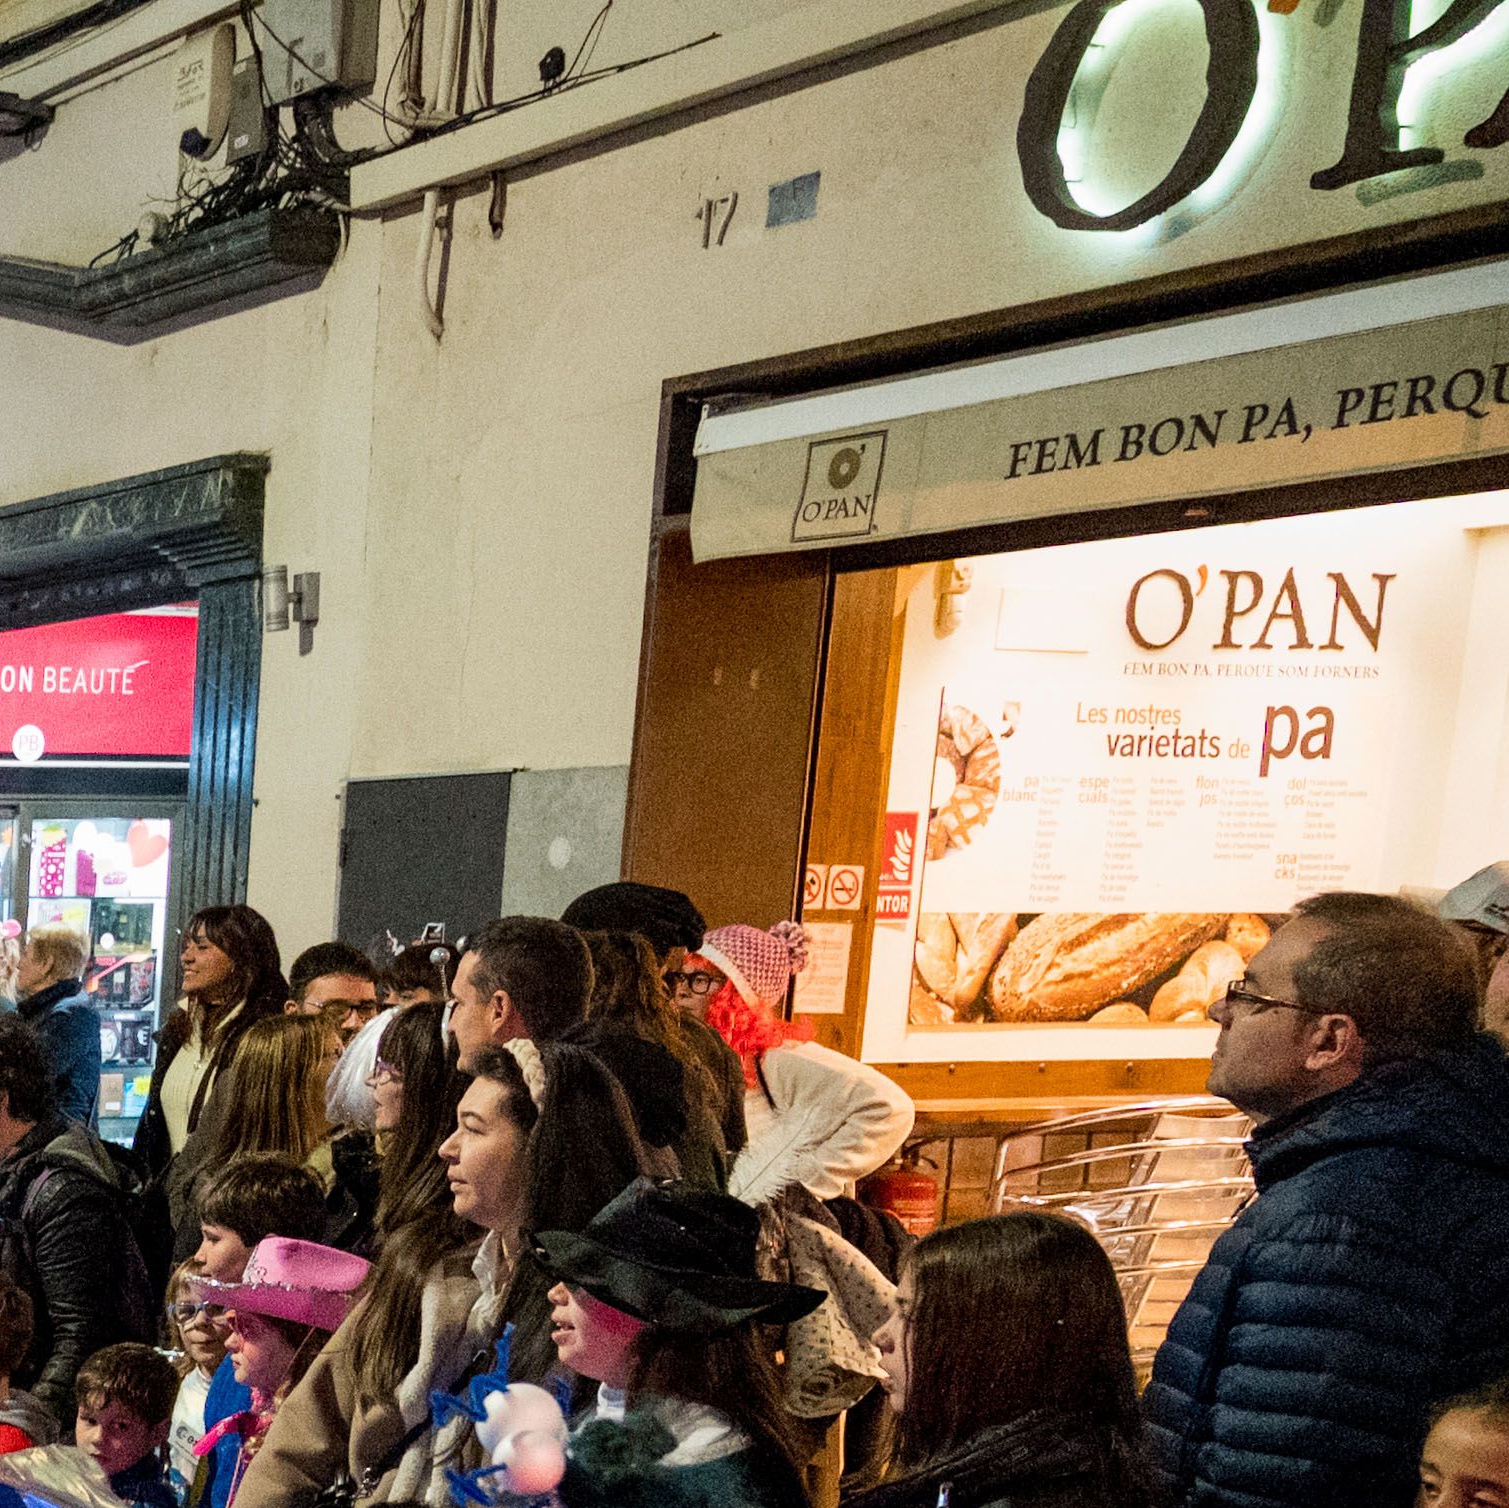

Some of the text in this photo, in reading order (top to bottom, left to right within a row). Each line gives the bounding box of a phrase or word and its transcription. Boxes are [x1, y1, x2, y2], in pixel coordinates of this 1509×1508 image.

[1016, 0, 1509, 233] OP
[695, 190, 738, 250] 17
[1005, 430, 1101, 481] FEM
[1117, 411, 1227, 463] BON
[1239, 402, 1312, 446] PA,
[802, 492, 873, 524] O'PAN
[1126, 564, 1397, 652] O'PAN
[43, 660, 149, 695] BEAUTÉ
[1123, 663, 1155, 676] FEM
[1156, 663, 1189, 677] BON
[1278, 665, 1309, 679] SOM
[1313, 665, 1380, 680] FORNERS
[1076, 702, 1181, 726] Les nostres
[1107, 705, 1335, 778] varietats de pa
[1024, 776, 1039, 789] pa
[1079, 776, 1110, 789] espe
[1287, 775, 1307, 790] dol
[1002, 788, 1038, 802] blanc
[1078, 791, 1109, 804] cials
[1199, 791, 1218, 808] jos
[1276, 853, 1298, 865] sna
[1274, 866, 1296, 880] cks
